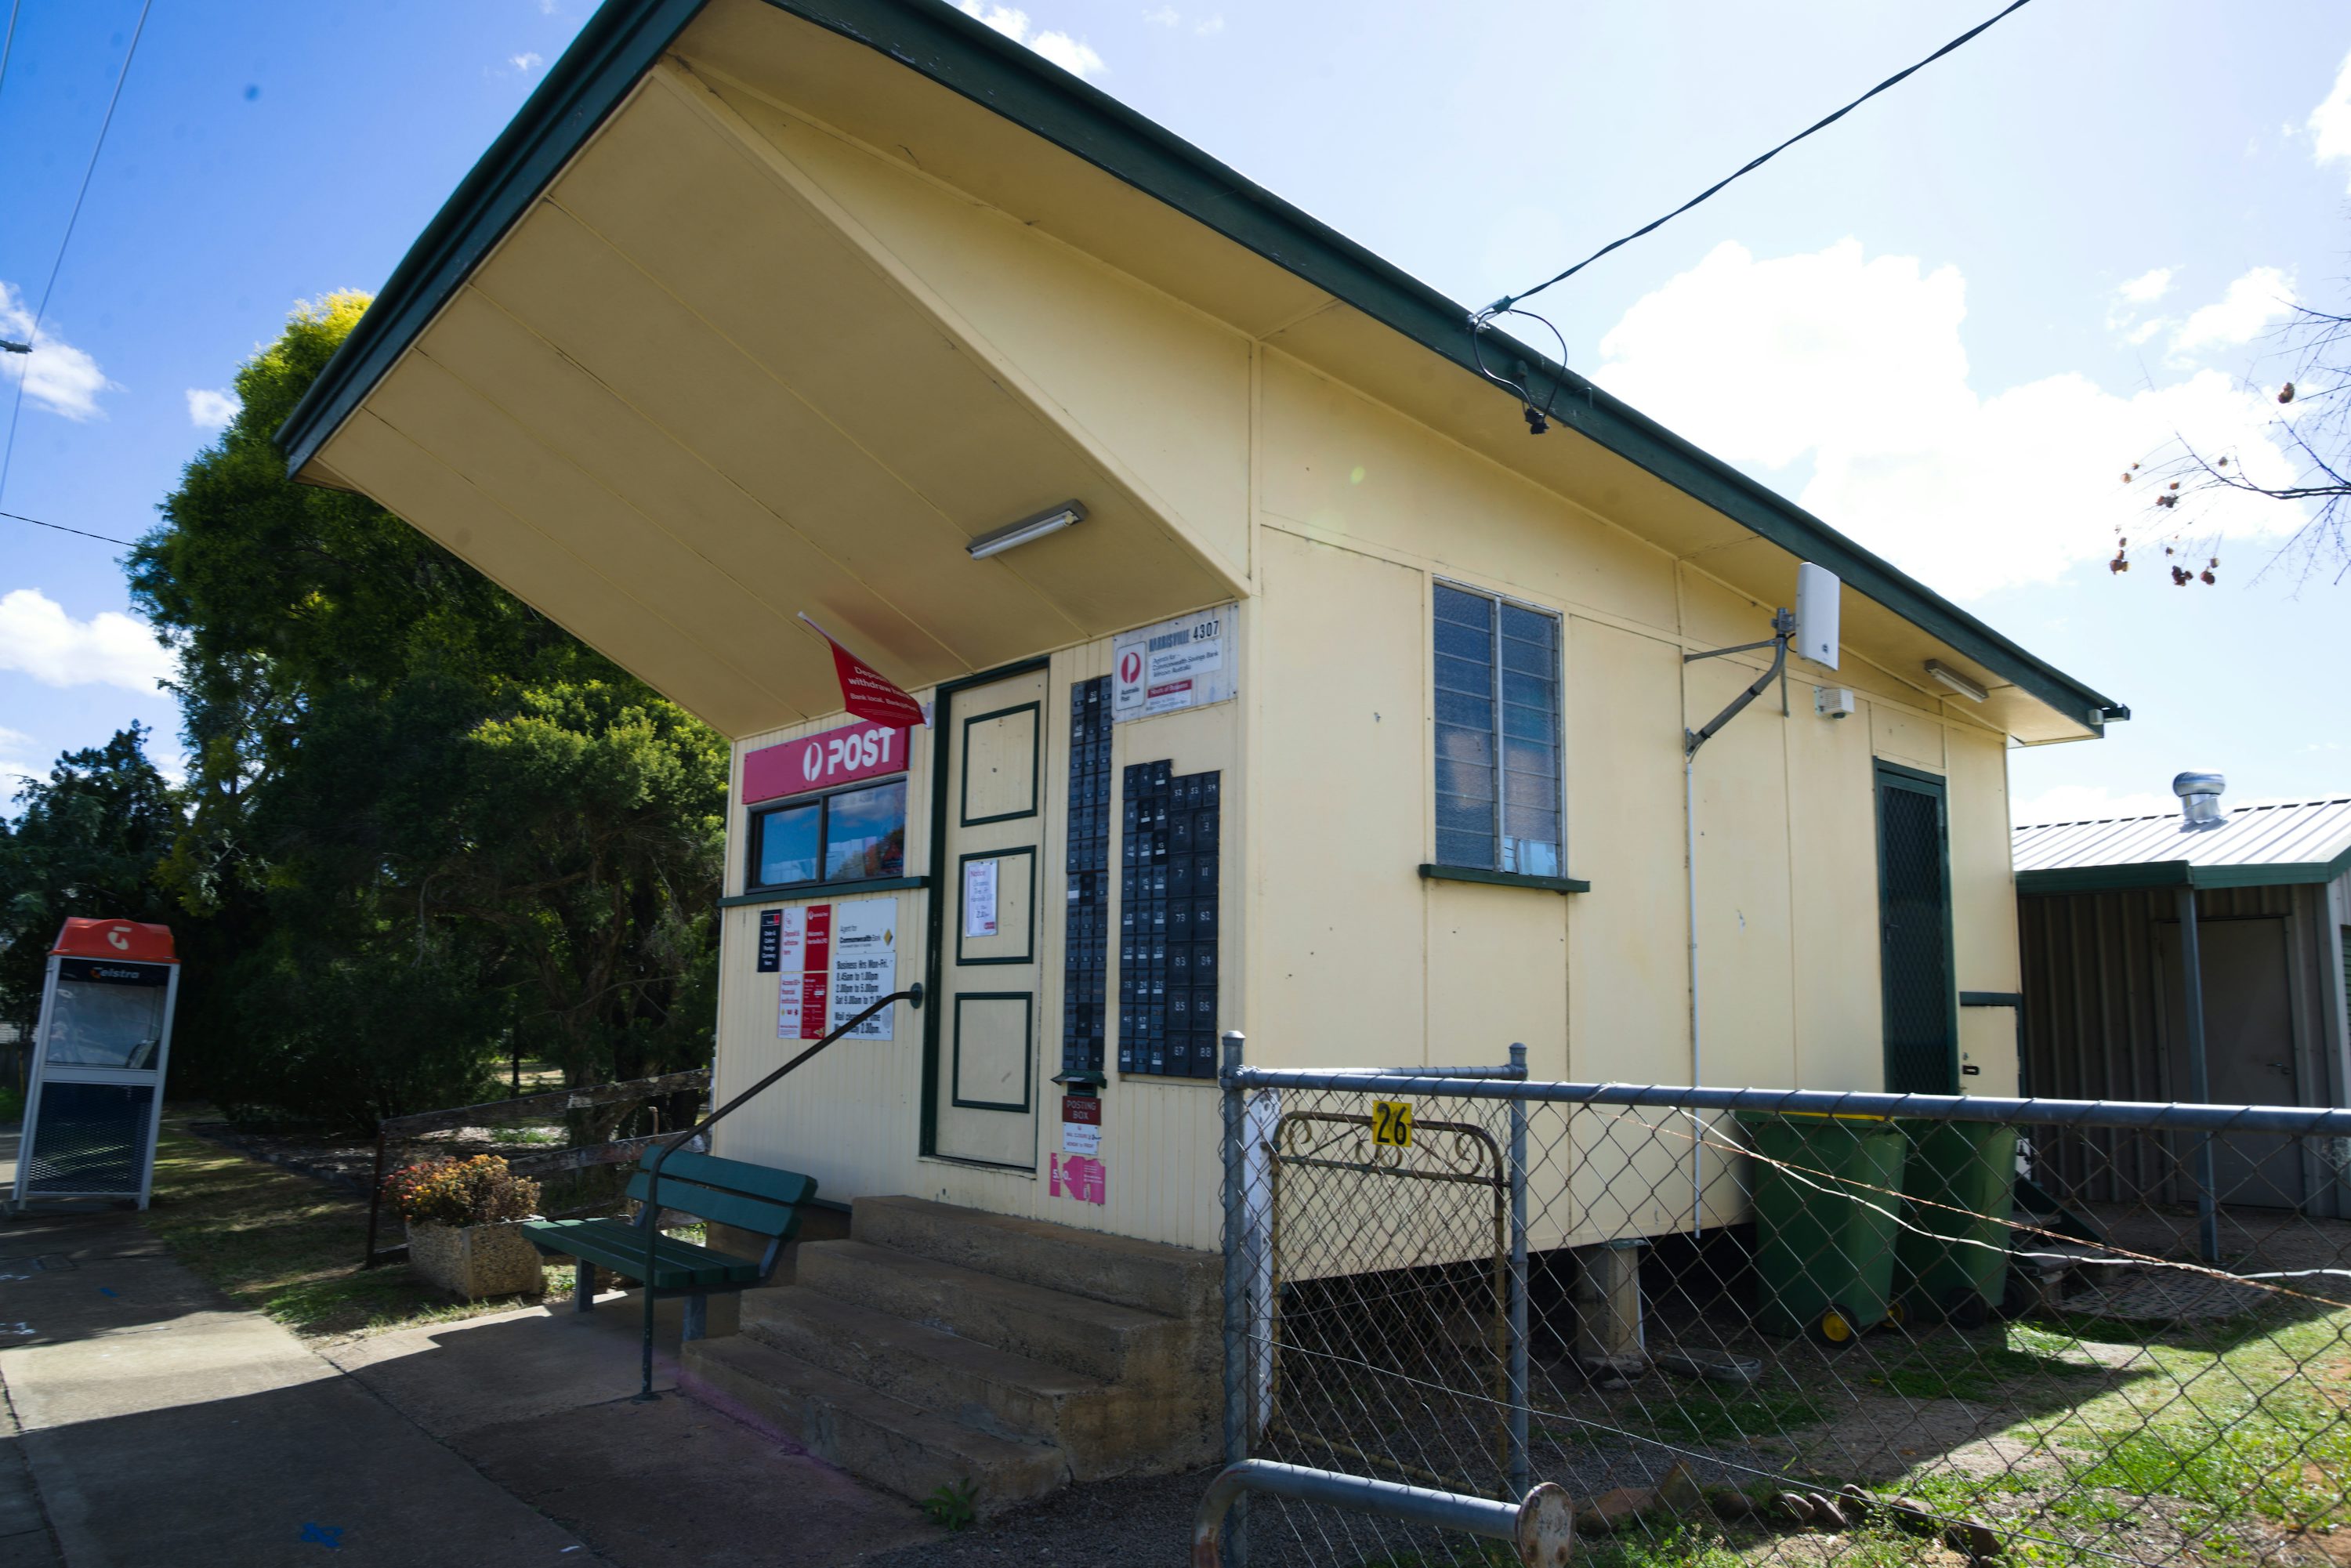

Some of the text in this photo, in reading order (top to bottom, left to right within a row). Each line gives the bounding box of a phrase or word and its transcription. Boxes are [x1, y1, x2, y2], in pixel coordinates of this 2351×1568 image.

[1149, 621, 1219, 652] HARRISVILLE 4307
[1206, 650, 1219, 659] Bank
[848, 678, 892, 693] withdraw
[1121, 686, 1139, 695] Australia
[827, 727, 896, 775] POST
[1204, 822, 1210, 831] 3
[1178, 869, 1184, 878] 7
[1201, 867, 1208, 876] 11
[1176, 914, 1186, 922] 73
[1201, 911, 1211, 921] 82
[840, 925, 852, 934] Agent
[836, 961, 857, 969] Business
[1176, 957, 1186, 966] 83
[1201, 956, 1212, 965] 84
[89, 966, 139, 980] Telstra
[836, 972, 853, 981] 8.45am
[860, 972, 878, 983] 1.00pm
[836, 983, 853, 994] 2.00pm
[860, 983, 878, 994] 5.00pm
[844, 995, 861, 1004] 9.00am
[1176, 1001, 1186, 1011] 85
[1200, 1001, 1210, 1012] 86
[835, 1012, 844, 1020] Mail
[1175, 1046, 1184, 1056] 87
[1201, 1047, 1212, 1057] 88
[1066, 1100, 1096, 1110] POSTING
[1072, 1110, 1089, 1120] BOX
[1376, 1103, 1407, 1145] 26
